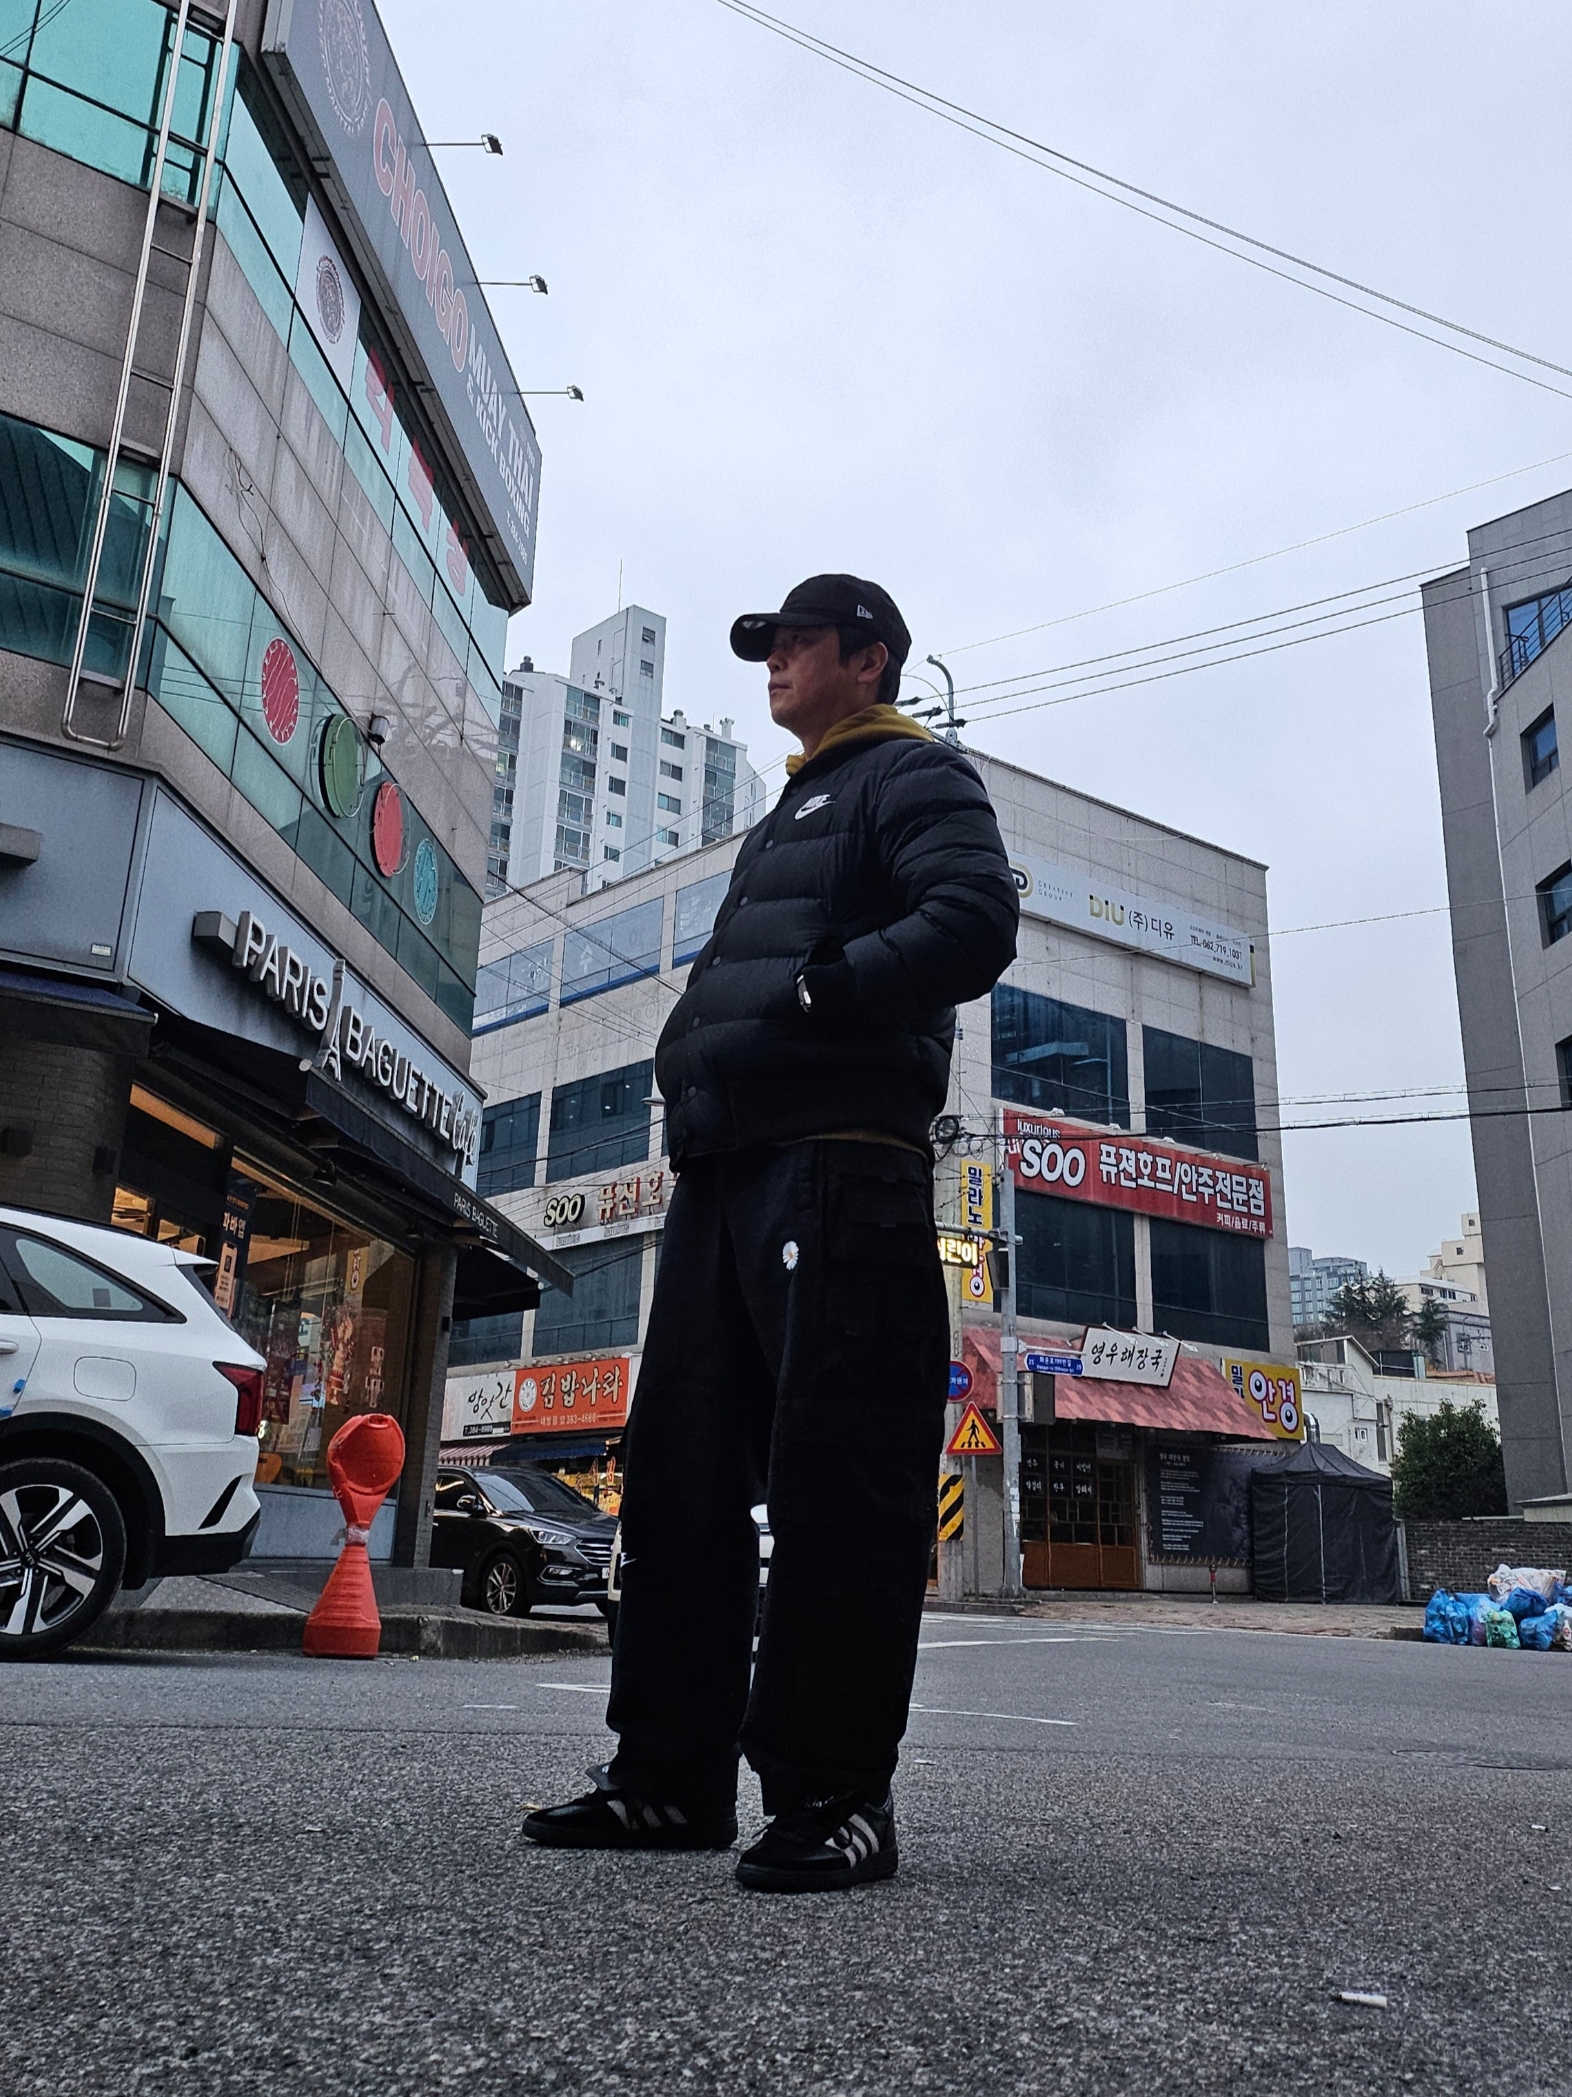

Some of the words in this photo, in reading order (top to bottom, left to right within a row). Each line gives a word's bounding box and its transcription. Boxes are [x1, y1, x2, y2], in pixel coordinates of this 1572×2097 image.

[373, 98, 469, 372] CHOIGO
[468, 323, 506, 440] MUAY
[508, 419, 534, 513] THAI
[466, 373, 475, 406] &
[475, 395, 499, 464] KICK
[500, 451, 531, 538] BOXING
[236, 911, 328, 1031] PARIS
[345, 1005, 451, 1140] BAGUETTE
[1017, 1118, 1061, 1138] luxurious
[1020, 1138, 1086, 1187] SOO
[453, 1192, 472, 1219] PARIS
[471, 1206, 499, 1238] BAGUETTE
[543, 1193, 585, 1228] SOO
[967, 1166, 983, 1226] 밀라노
[1091, 1341, 1163, 1373] 영우해장국
[540, 1364, 624, 1410] 김밥나라
[1248, 1369, 1299, 1434] 안경
